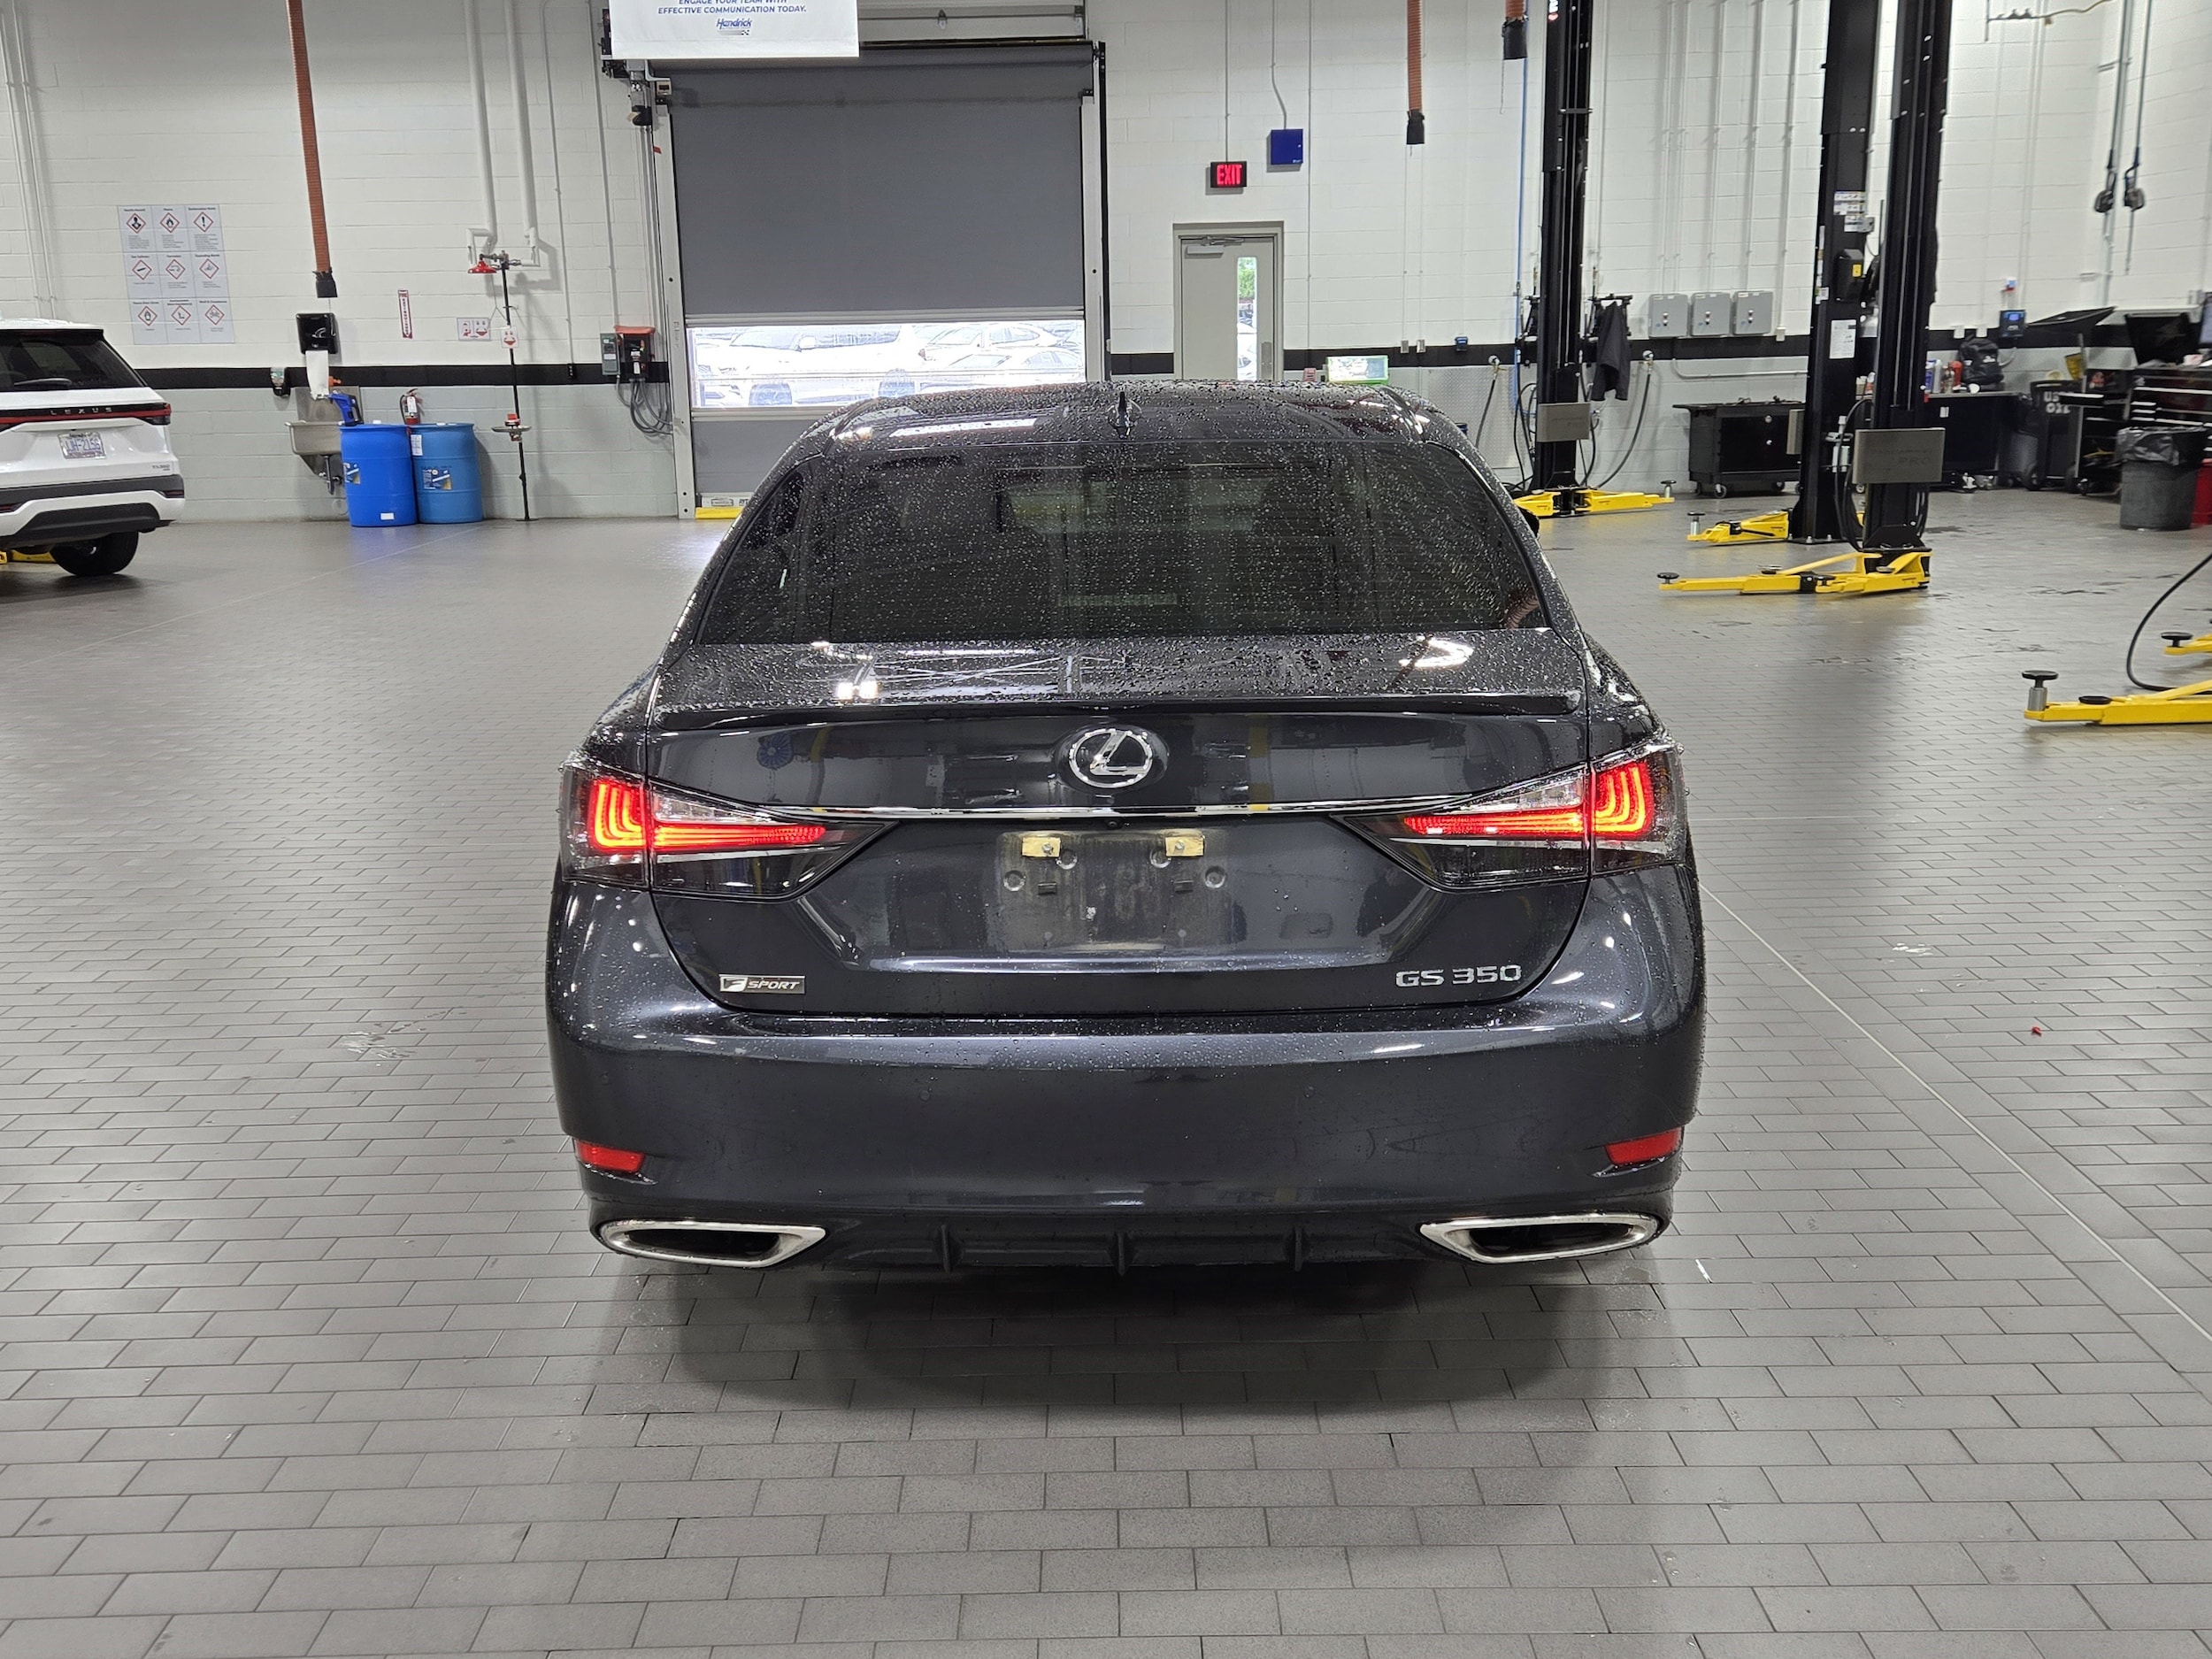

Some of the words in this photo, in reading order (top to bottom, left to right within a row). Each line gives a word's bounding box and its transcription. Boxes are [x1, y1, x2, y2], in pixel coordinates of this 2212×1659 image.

[716, 18, 752, 29] Hendrick
[1217, 164, 1242, 186] EXIT
[50, 407, 112, 416] LEXUS
[1395, 970, 1445, 987] GS
[1452, 964, 1523, 985] 350
[747, 980, 801, 990] SPORT
